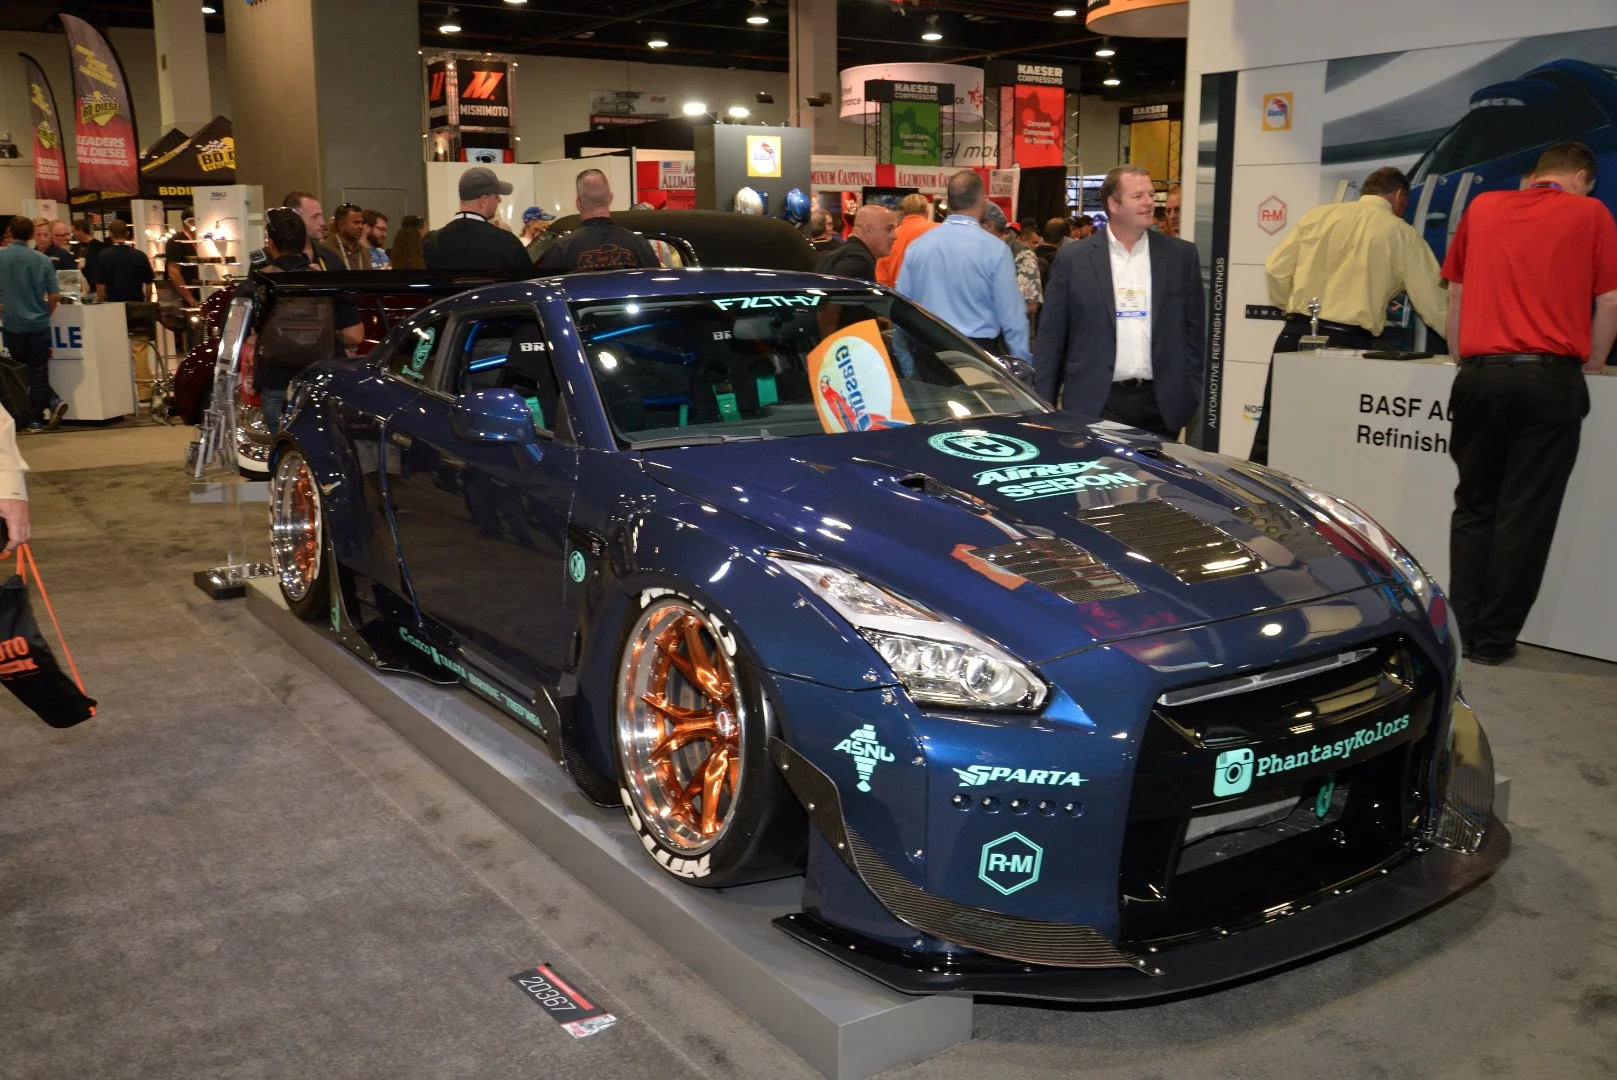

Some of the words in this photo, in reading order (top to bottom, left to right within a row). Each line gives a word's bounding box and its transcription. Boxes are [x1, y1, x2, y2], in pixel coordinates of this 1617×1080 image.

[1017, 64, 1063, 77] KAESER
[1017, 75, 1063, 85] COMPRESSORS
[894, 83, 938, 94] KAESER
[894, 92, 938, 101] COMPRESSORS
[460, 105, 508, 117] MISHIMOTO
[1132, 104, 1169, 115] KAESER
[89, 147, 127, 159] DIESEL
[201, 152, 224, 165] BD
[837, 169, 874, 187] CASTINGS
[1262, 209, 1283, 221] R-M
[1214, 257, 1225, 311] COATINGS
[1211, 313, 1222, 360] REFINISH
[1208, 363, 1220, 429] AUTOMOTIVE
[1359, 393, 1422, 418] BASF
[1357, 424, 1447, 453] Refinish
[833, 738, 896, 763] ASNU
[1256, 714, 1410, 777] PhantasyKolors
[952, 764, 1090, 787] SPARTA
[988, 853, 1034, 873] R-M
[519, 976, 577, 1011] 20367
